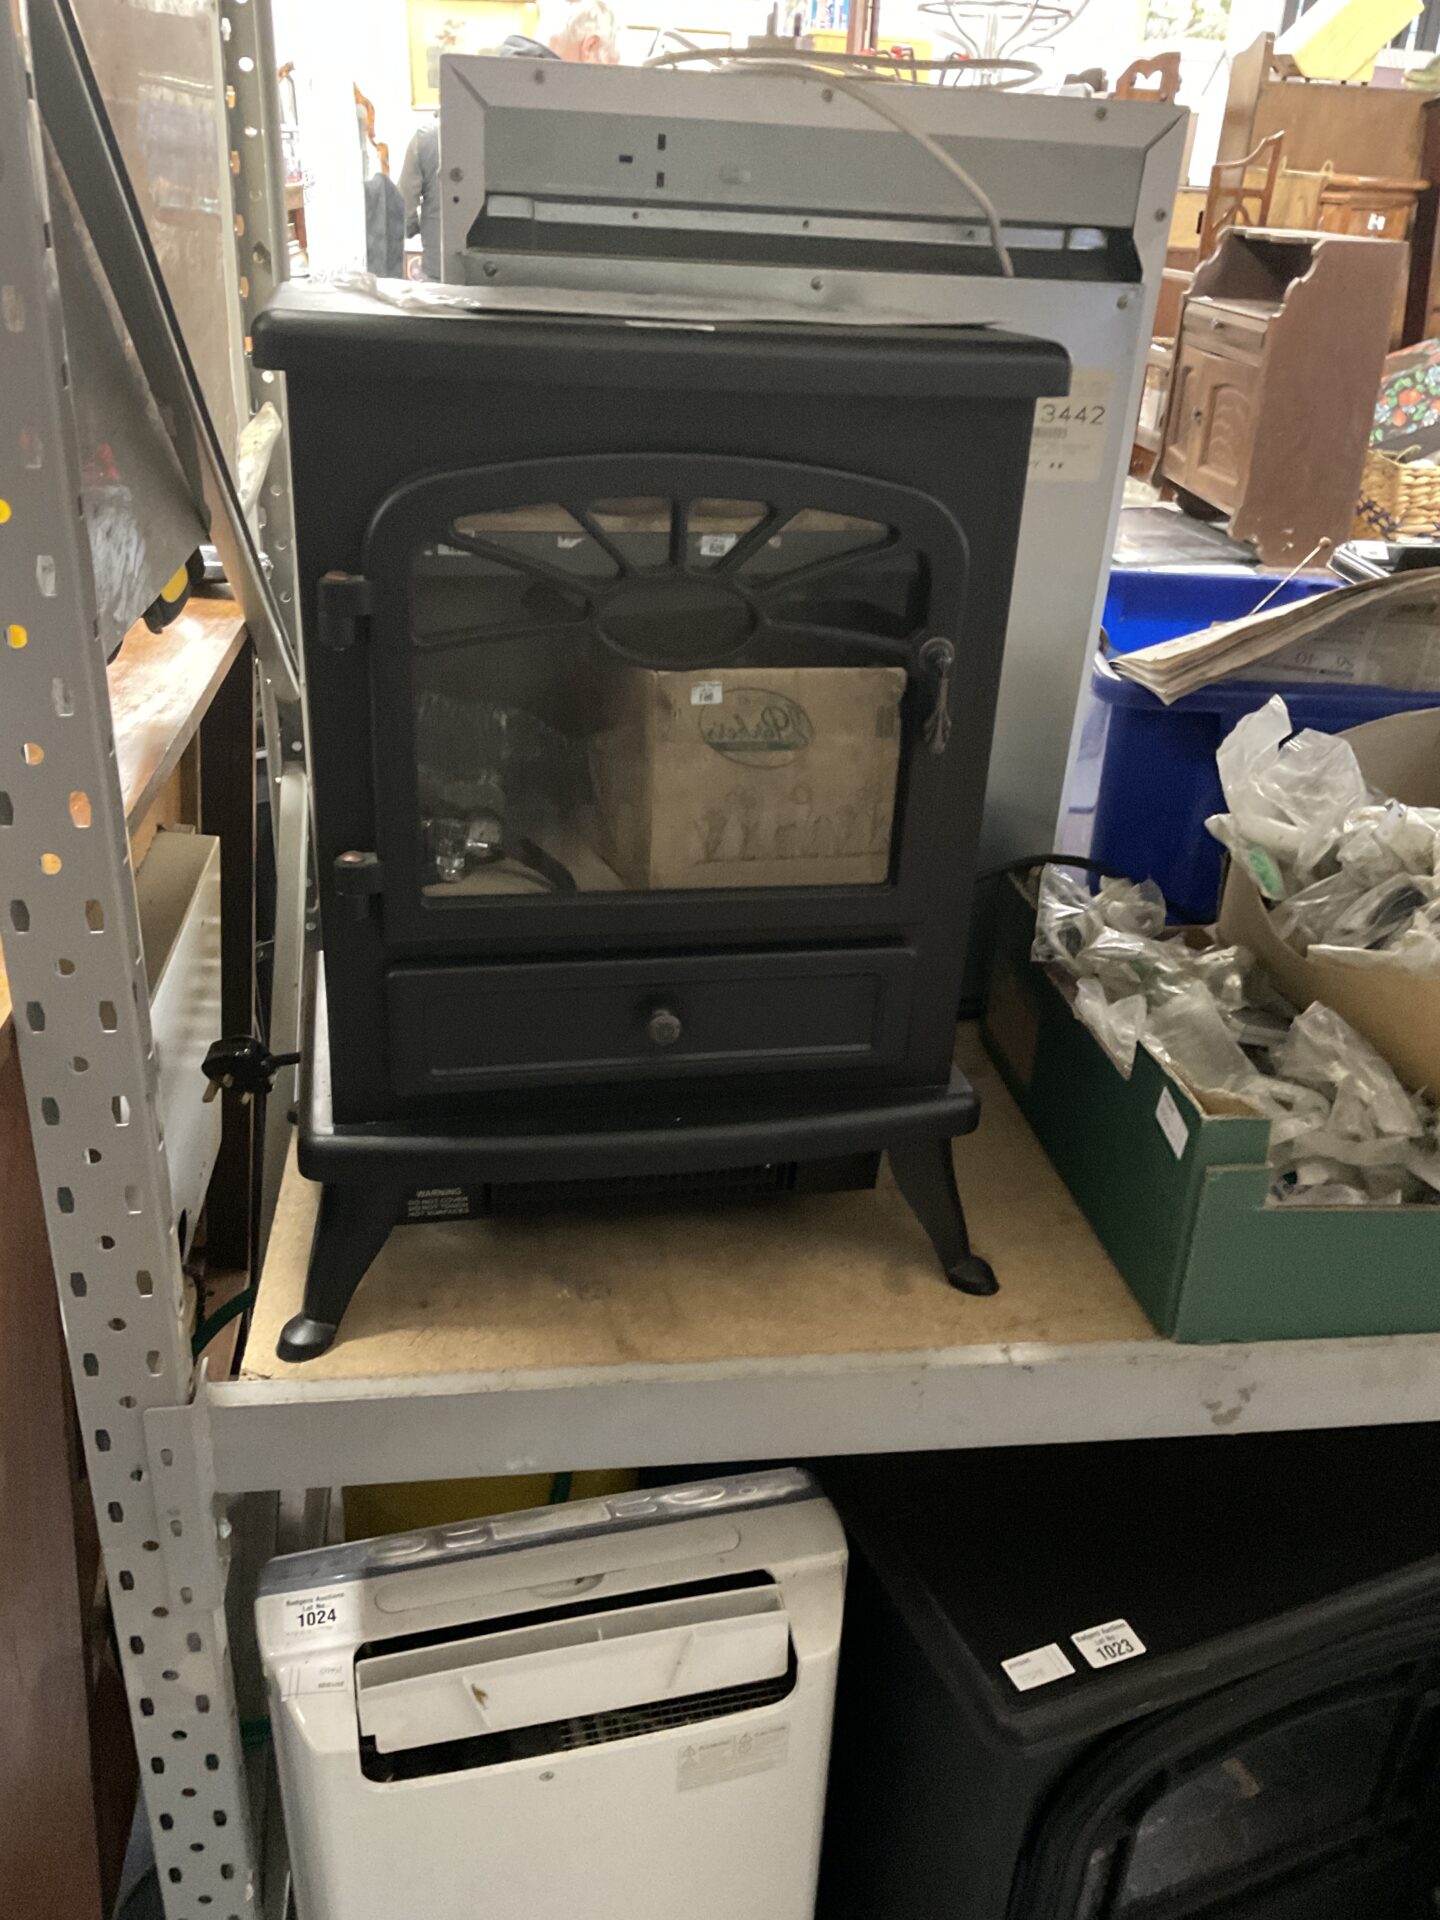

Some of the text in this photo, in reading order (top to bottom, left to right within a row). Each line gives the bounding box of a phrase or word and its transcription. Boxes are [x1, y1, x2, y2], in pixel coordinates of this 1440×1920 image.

[416, 1187, 462, 1197] WARNING
[303, 1604, 314, 1612] Lot
[298, 1608, 337, 1627] 1024
[1096, 1638, 1134, 1661] 1023
